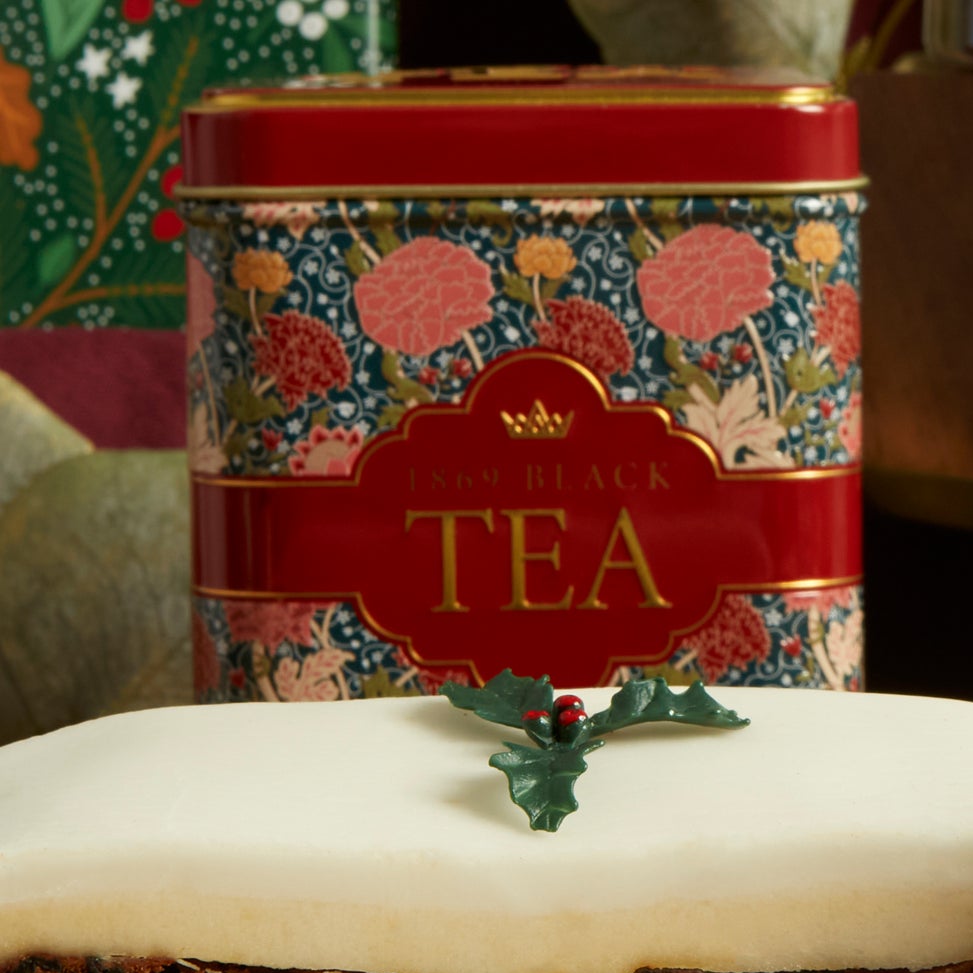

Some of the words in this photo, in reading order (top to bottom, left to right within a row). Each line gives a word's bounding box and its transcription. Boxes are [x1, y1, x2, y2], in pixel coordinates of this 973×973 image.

[408, 465, 500, 493] 1869
[525, 462, 671, 492] BLACK
[405, 507, 673, 612] TEA
